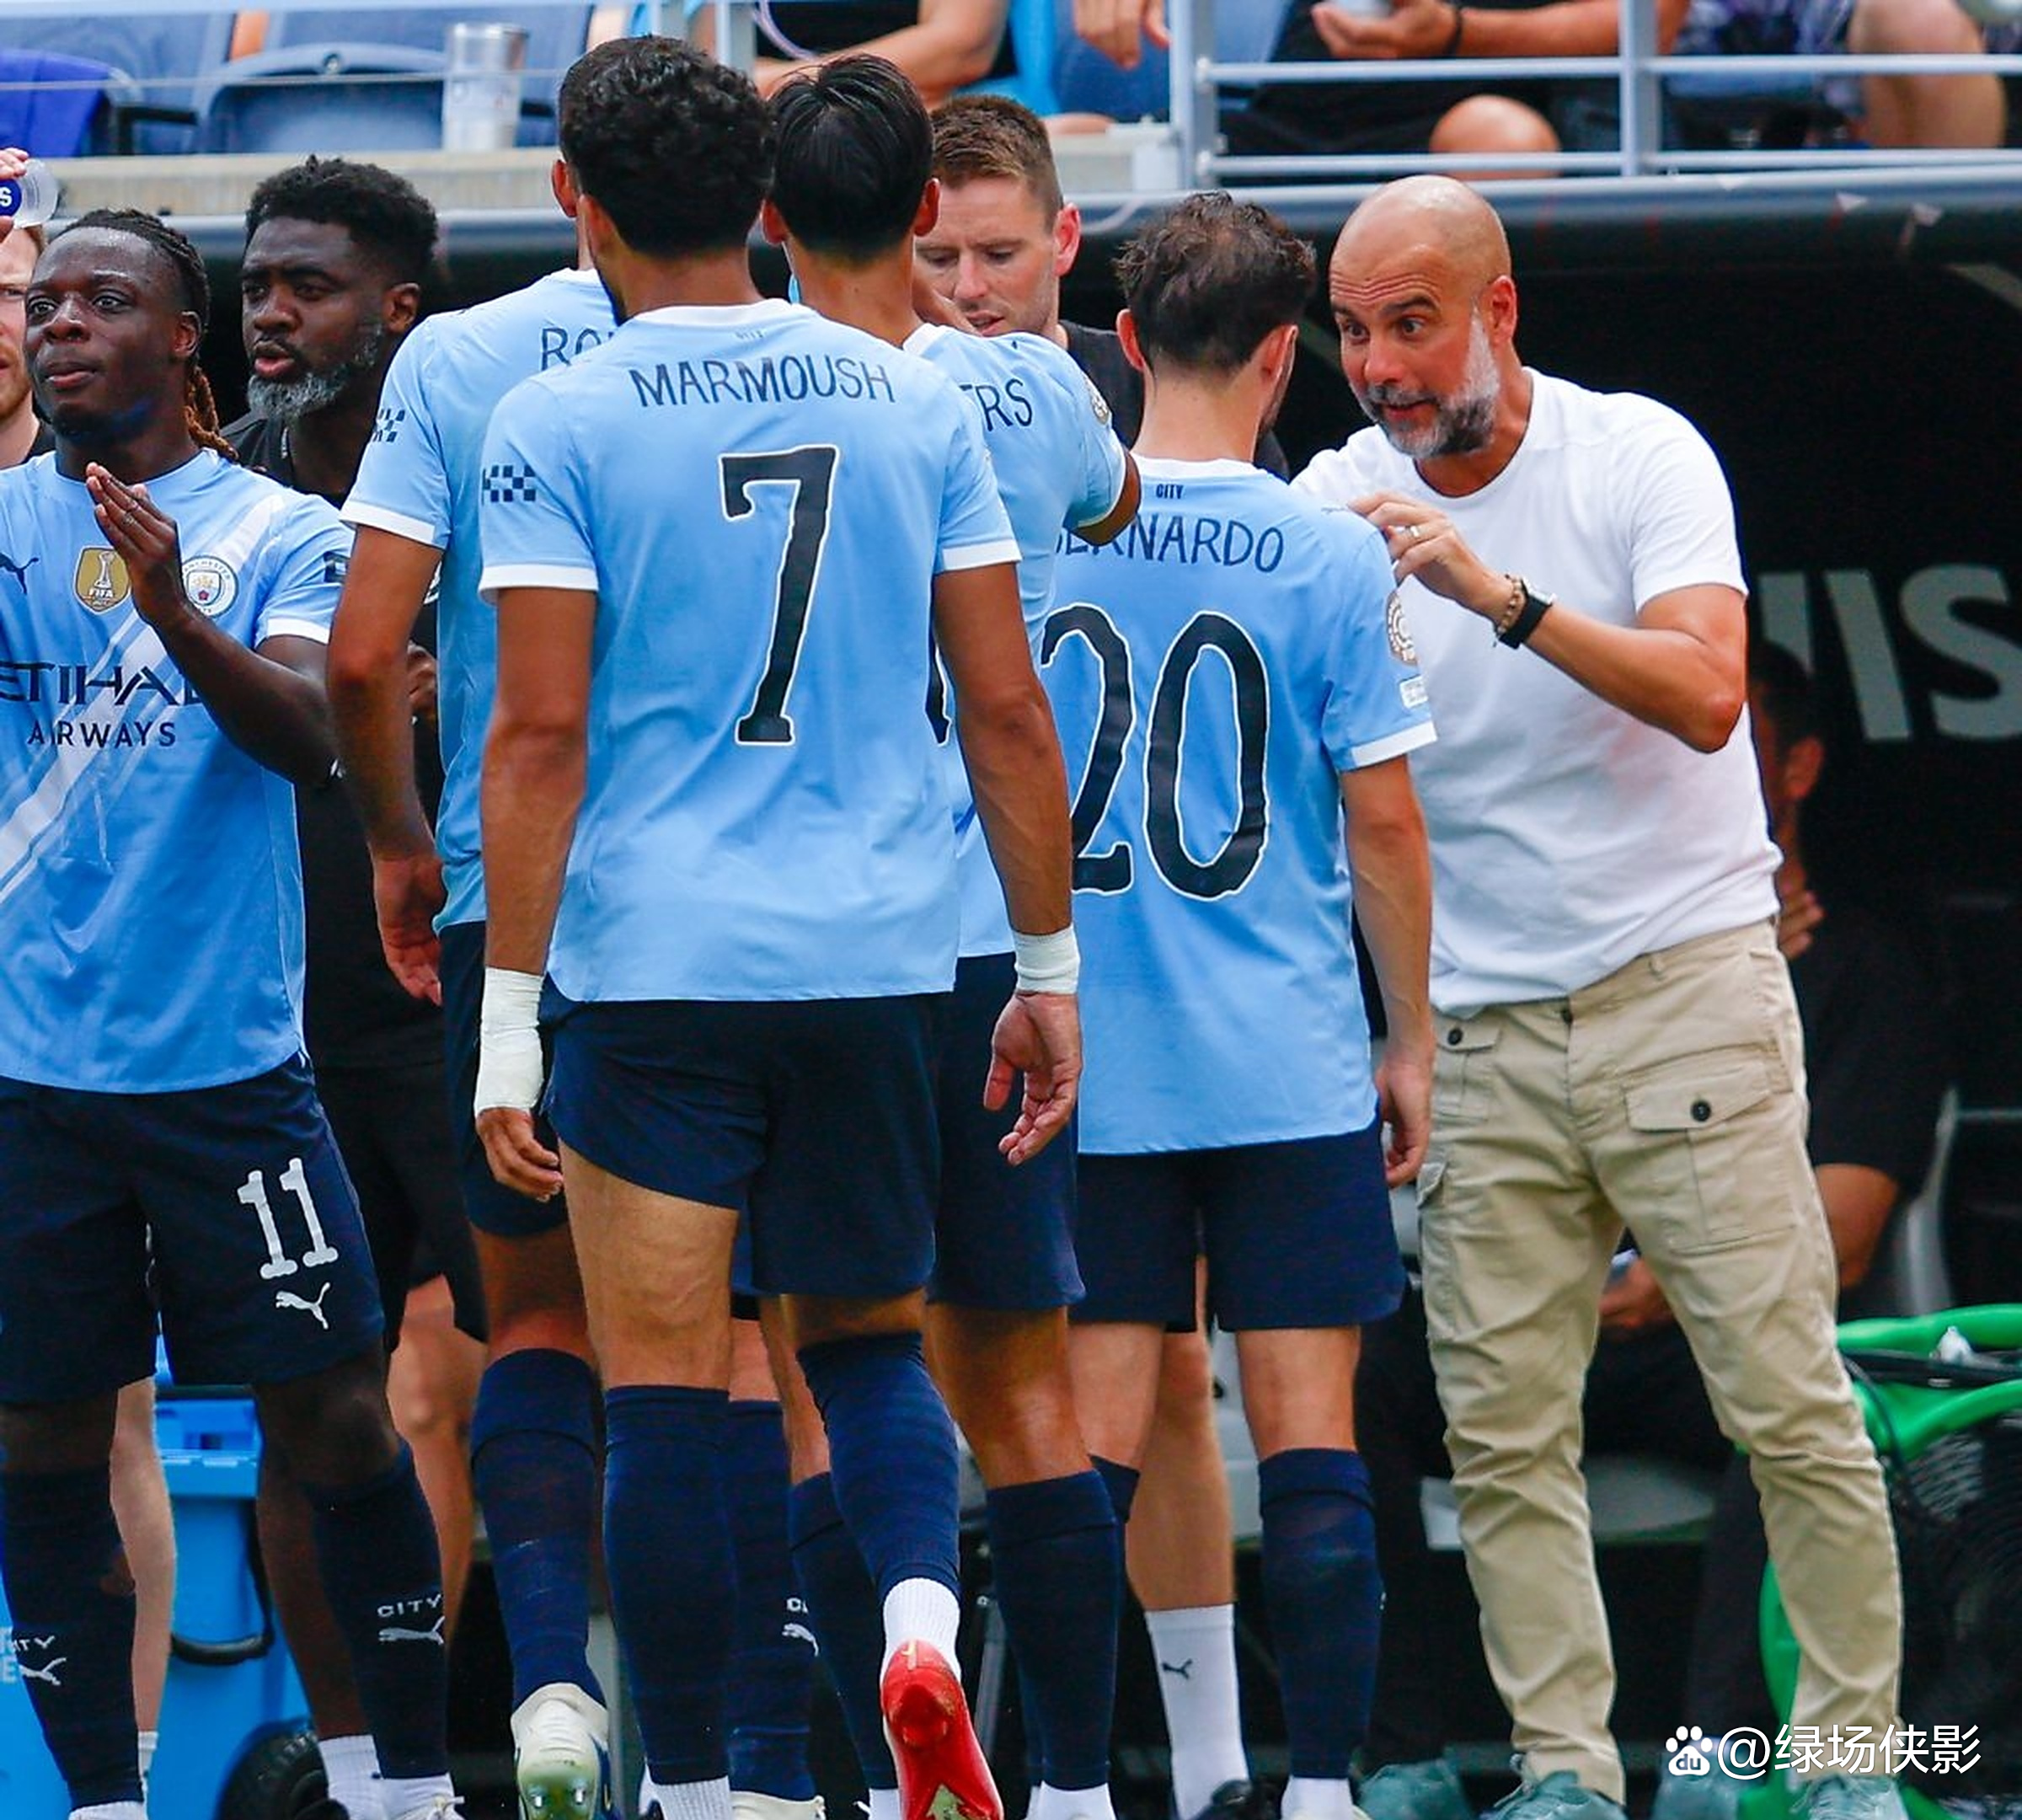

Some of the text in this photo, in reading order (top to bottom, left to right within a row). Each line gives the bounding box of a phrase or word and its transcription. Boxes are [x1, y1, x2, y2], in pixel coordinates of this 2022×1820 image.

[541, 327, 613, 371] RO
[629, 355, 896, 407] MARMOUSH
[959, 378, 1032, 431] RS
[1155, 484, 1184, 499] CITY
[1056, 513, 1284, 573] NARDO
[717, 444, 838, 746] 7
[1040, 602, 1270, 902] 20
[237, 1158, 339, 1279] 11
[377, 1593, 441, 1617] CITY
